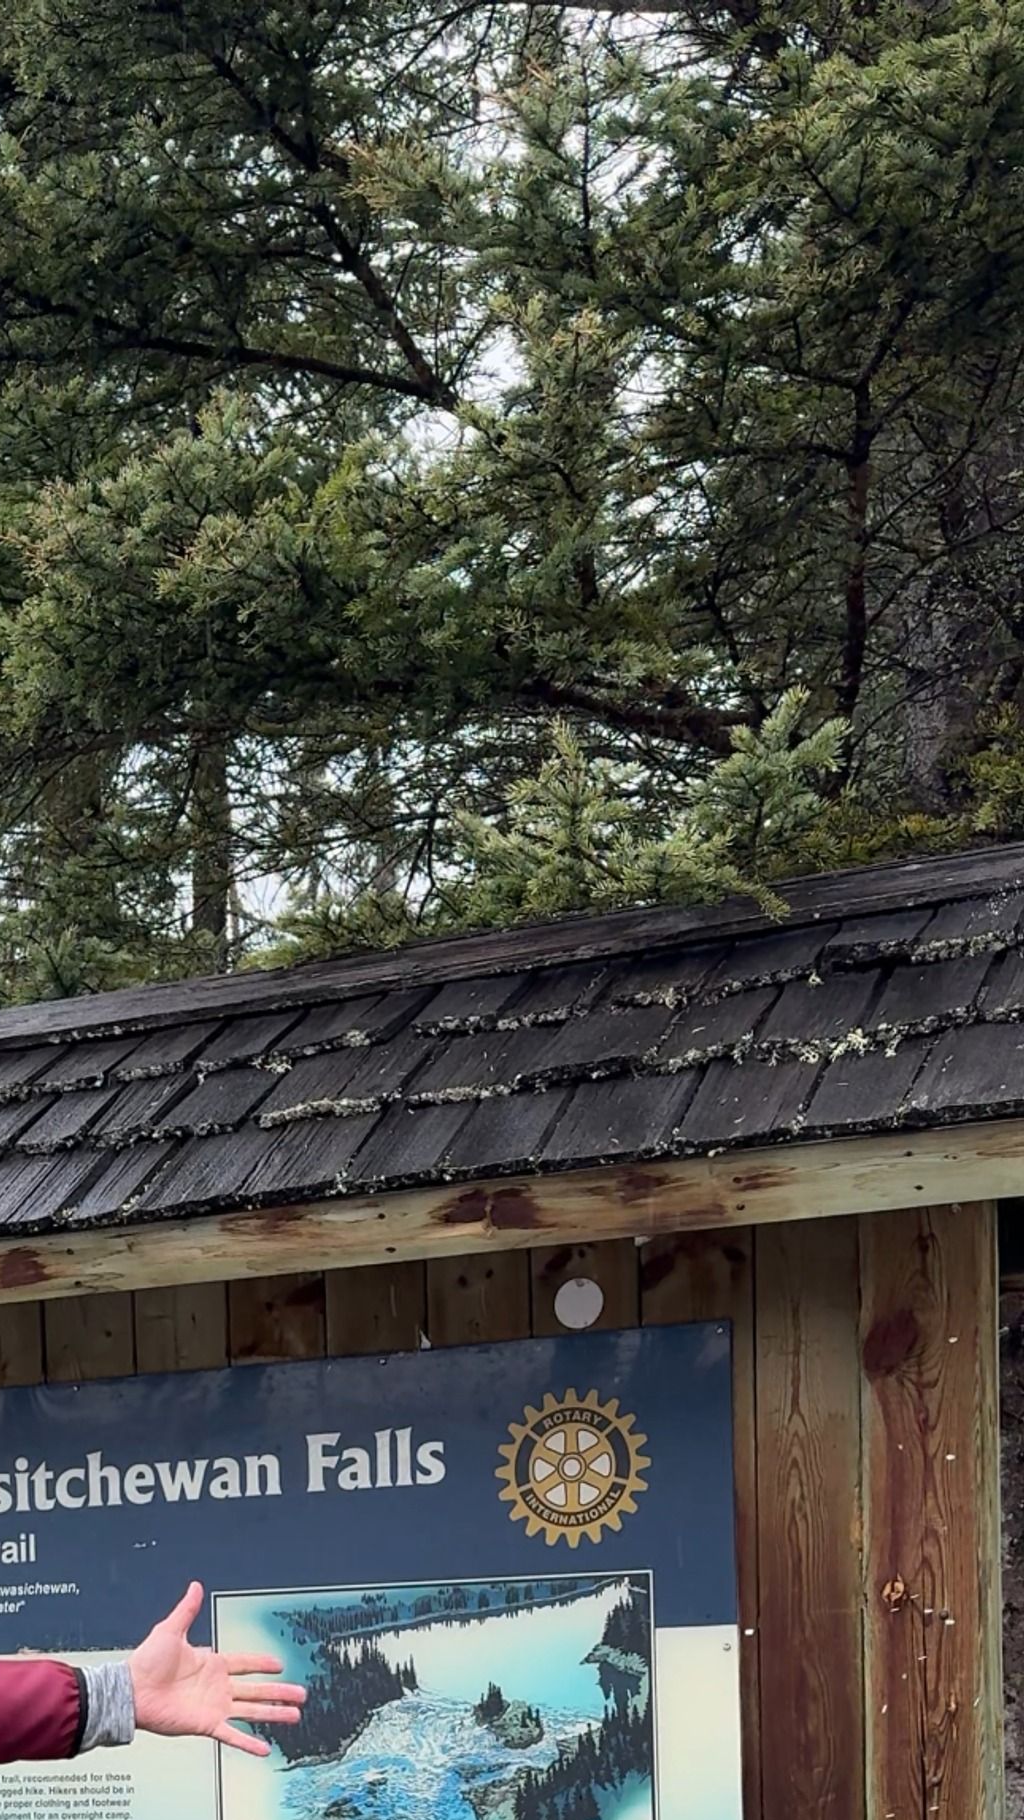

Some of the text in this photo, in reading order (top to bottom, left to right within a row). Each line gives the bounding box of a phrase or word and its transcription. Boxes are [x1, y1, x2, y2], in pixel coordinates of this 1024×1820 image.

[543, 1410, 603, 1429] ROTARY
[305, 1426, 445, 1492] Falls
[525, 1488, 622, 1525] INTERNATIONAL
